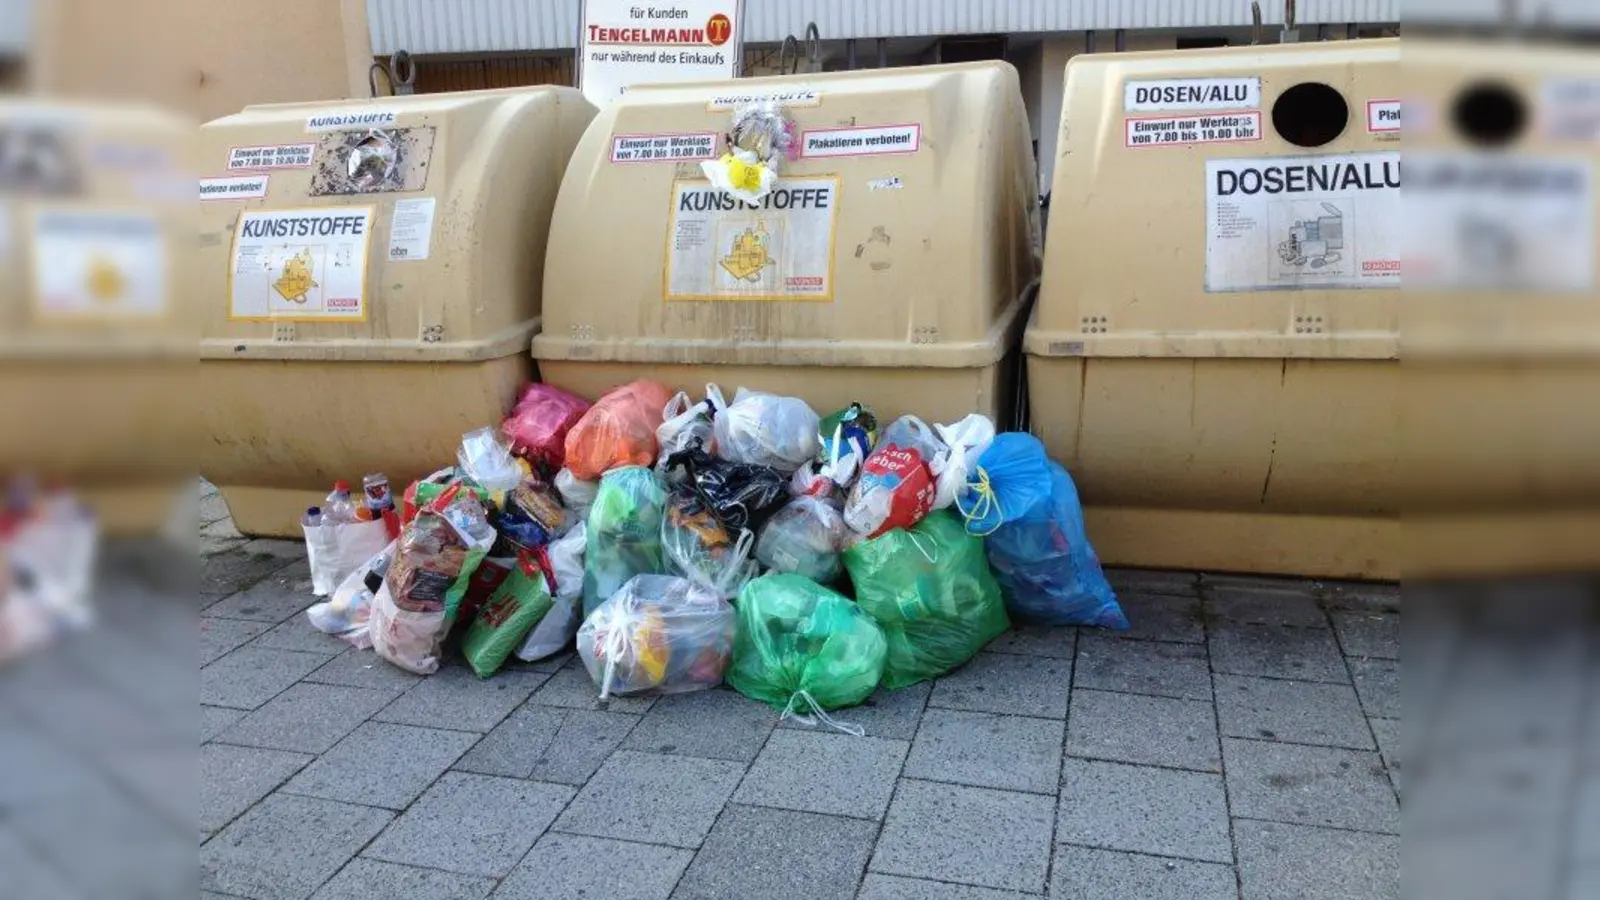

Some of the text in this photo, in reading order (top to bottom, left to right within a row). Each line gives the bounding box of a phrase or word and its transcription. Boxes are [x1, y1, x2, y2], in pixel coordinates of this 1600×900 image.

[630, 7, 688, 19] für Kunden
[589, 25, 704, 43] TENGELMANN
[591, 51, 725, 65] nur während des Einkaufs
[1135, 84, 1248, 104] DOSEN/ALU
[1134, 120, 1176, 132] Einwurf
[1178, 120, 1197, 130] nur
[808, 133, 911, 149] Plakatieren verboten!
[1132, 127, 1255, 144] von 7.00 bis 19.00 Uhr
[1217, 161, 1400, 196] DOSEN/ALU
[679, 188, 829, 211] KUNSTOFFE
[241, 216, 364, 238] KUNSTSTOFFE
